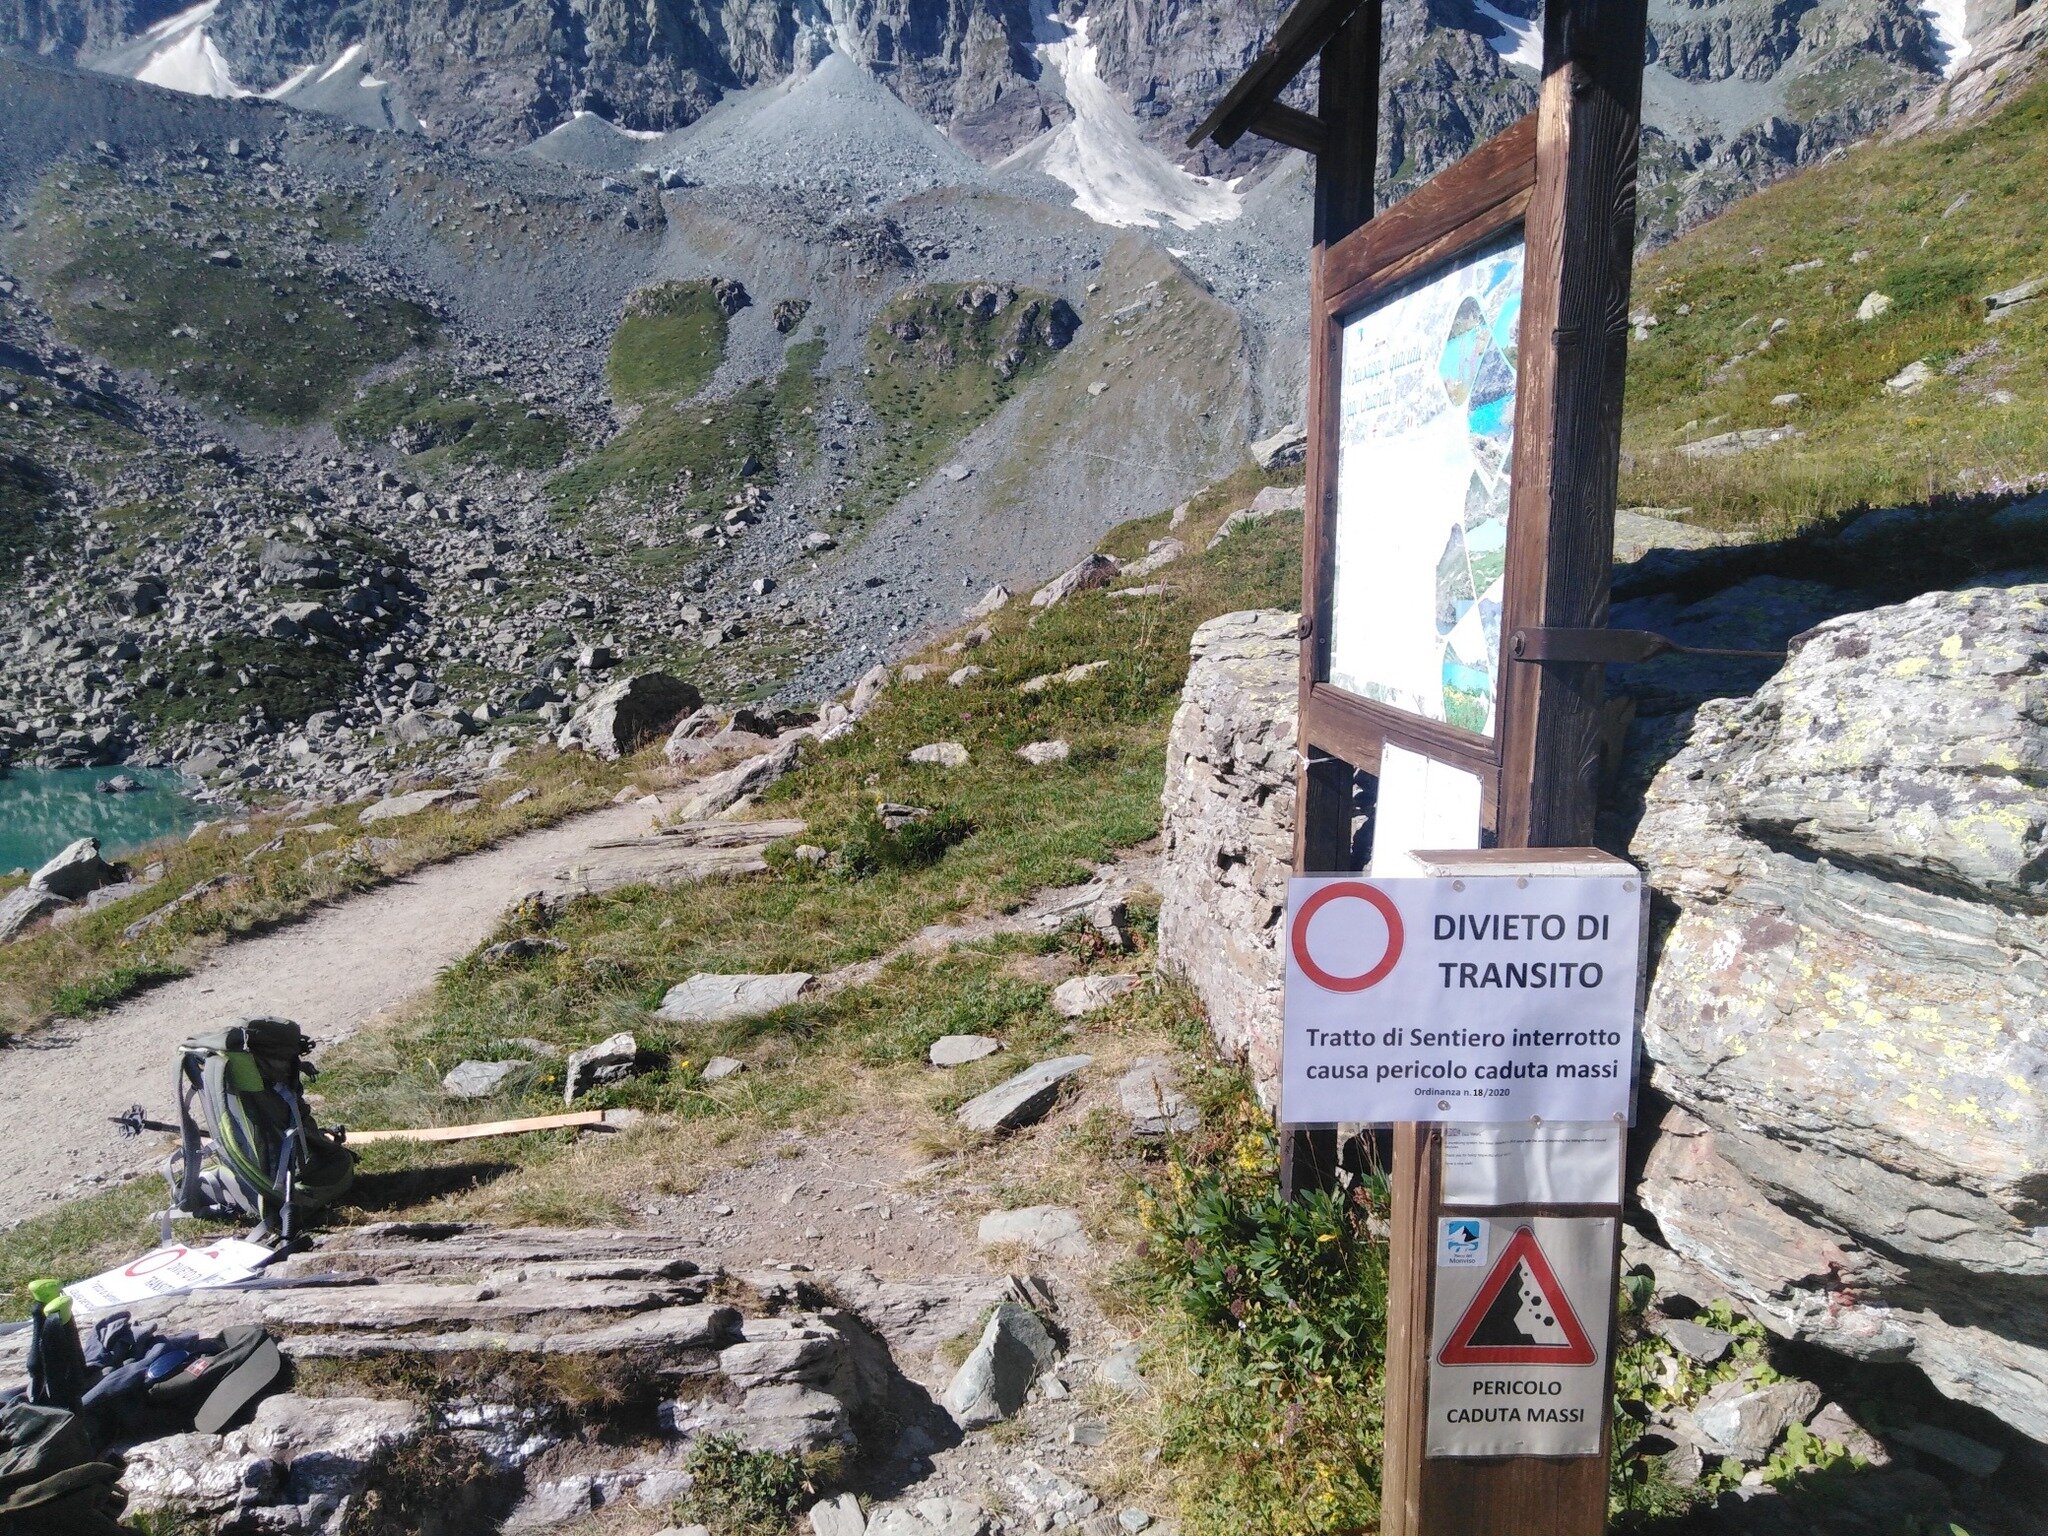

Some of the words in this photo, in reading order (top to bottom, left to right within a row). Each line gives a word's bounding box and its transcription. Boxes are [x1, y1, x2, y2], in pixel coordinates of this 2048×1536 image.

[1433, 914, 1566, 941] DIVIETO
[1577, 914, 1609, 941] DI
[1438, 962, 1604, 989] TRANSITO
[1306, 1028, 1376, 1047] Tratto
[1383, 1027, 1403, 1047] di
[1410, 1028, 1505, 1047] Sentiero
[1512, 1028, 1621, 1047] interrotto
[1306, 1063, 1368, 1079] causa
[1376, 1060, 1467, 1083] pericolo
[1474, 1060, 1548, 1080] caduta
[1556, 1060, 1618, 1079] massi
[1414, 1087, 1461, 1097] Ordinanza
[1473, 1087, 1510, 1098] 18/2020
[1473, 1381, 1562, 1396] PERICOLO
[1446, 1408, 1521, 1423] CADUTA
[1527, 1408, 1585, 1423] MASSI
